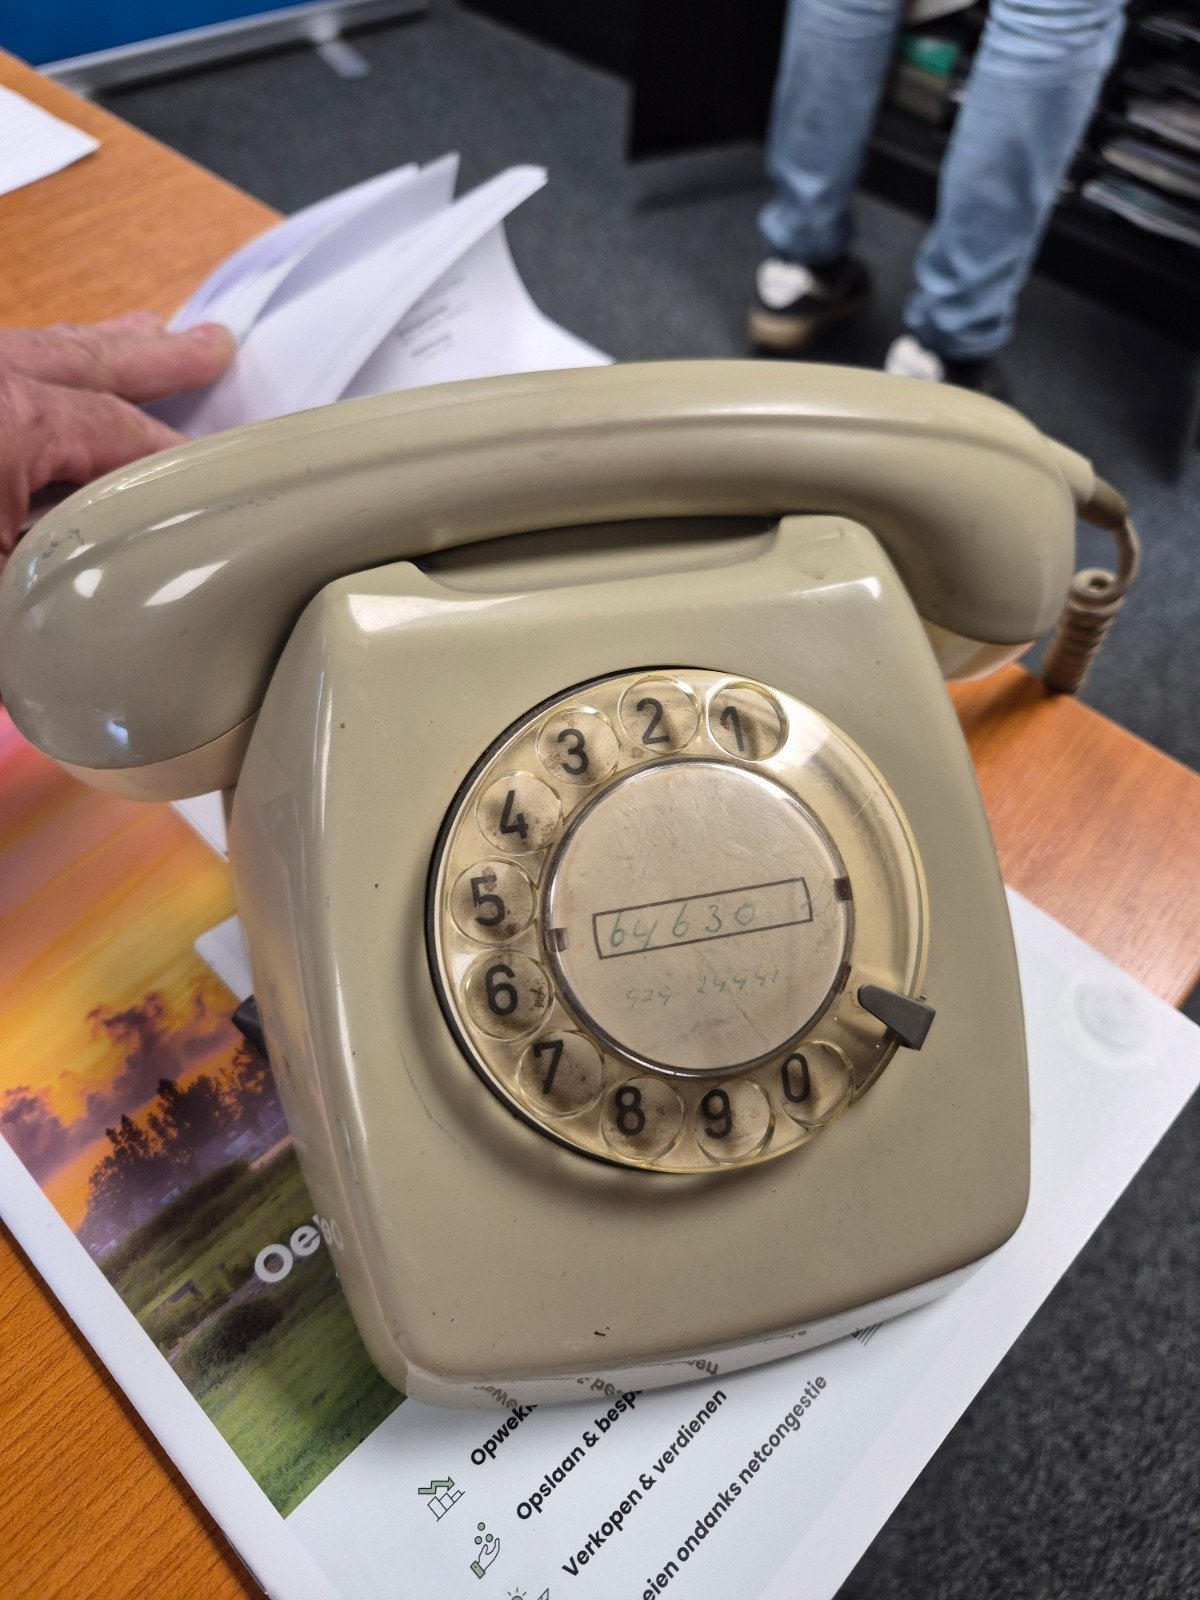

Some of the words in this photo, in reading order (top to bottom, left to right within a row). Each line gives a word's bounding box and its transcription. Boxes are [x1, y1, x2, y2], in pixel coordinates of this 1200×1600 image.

[636, 698, 669, 746] 2
[720, 706, 747, 753] 1
[557, 728, 589, 775] 3
[499, 790, 529, 840] 4
[470, 875, 506, 928] 5
[609, 901, 756, 950] 64630
[484, 964, 519, 1016] 6
[532, 1039, 565, 1095] 7
[780, 1052, 810, 1103] 0
[614, 1085, 646, 1137] 8
[702, 1087, 733, 1140] 9
[254, 1214, 322, 1283] Oe
[470, 1403, 539, 1466] Opwek
[516, 1446, 586, 1520] Opslaan
[582, 1431, 600, 1448] &
[594, 1390, 644, 1434] besp
[561, 1489, 643, 1578] Verkopen
[638, 1473, 657, 1491] &
[652, 1389, 727, 1474] verdienen
[676, 1482, 742, 1562] ondanks
[738, 1375, 827, 1485] netcongestie
